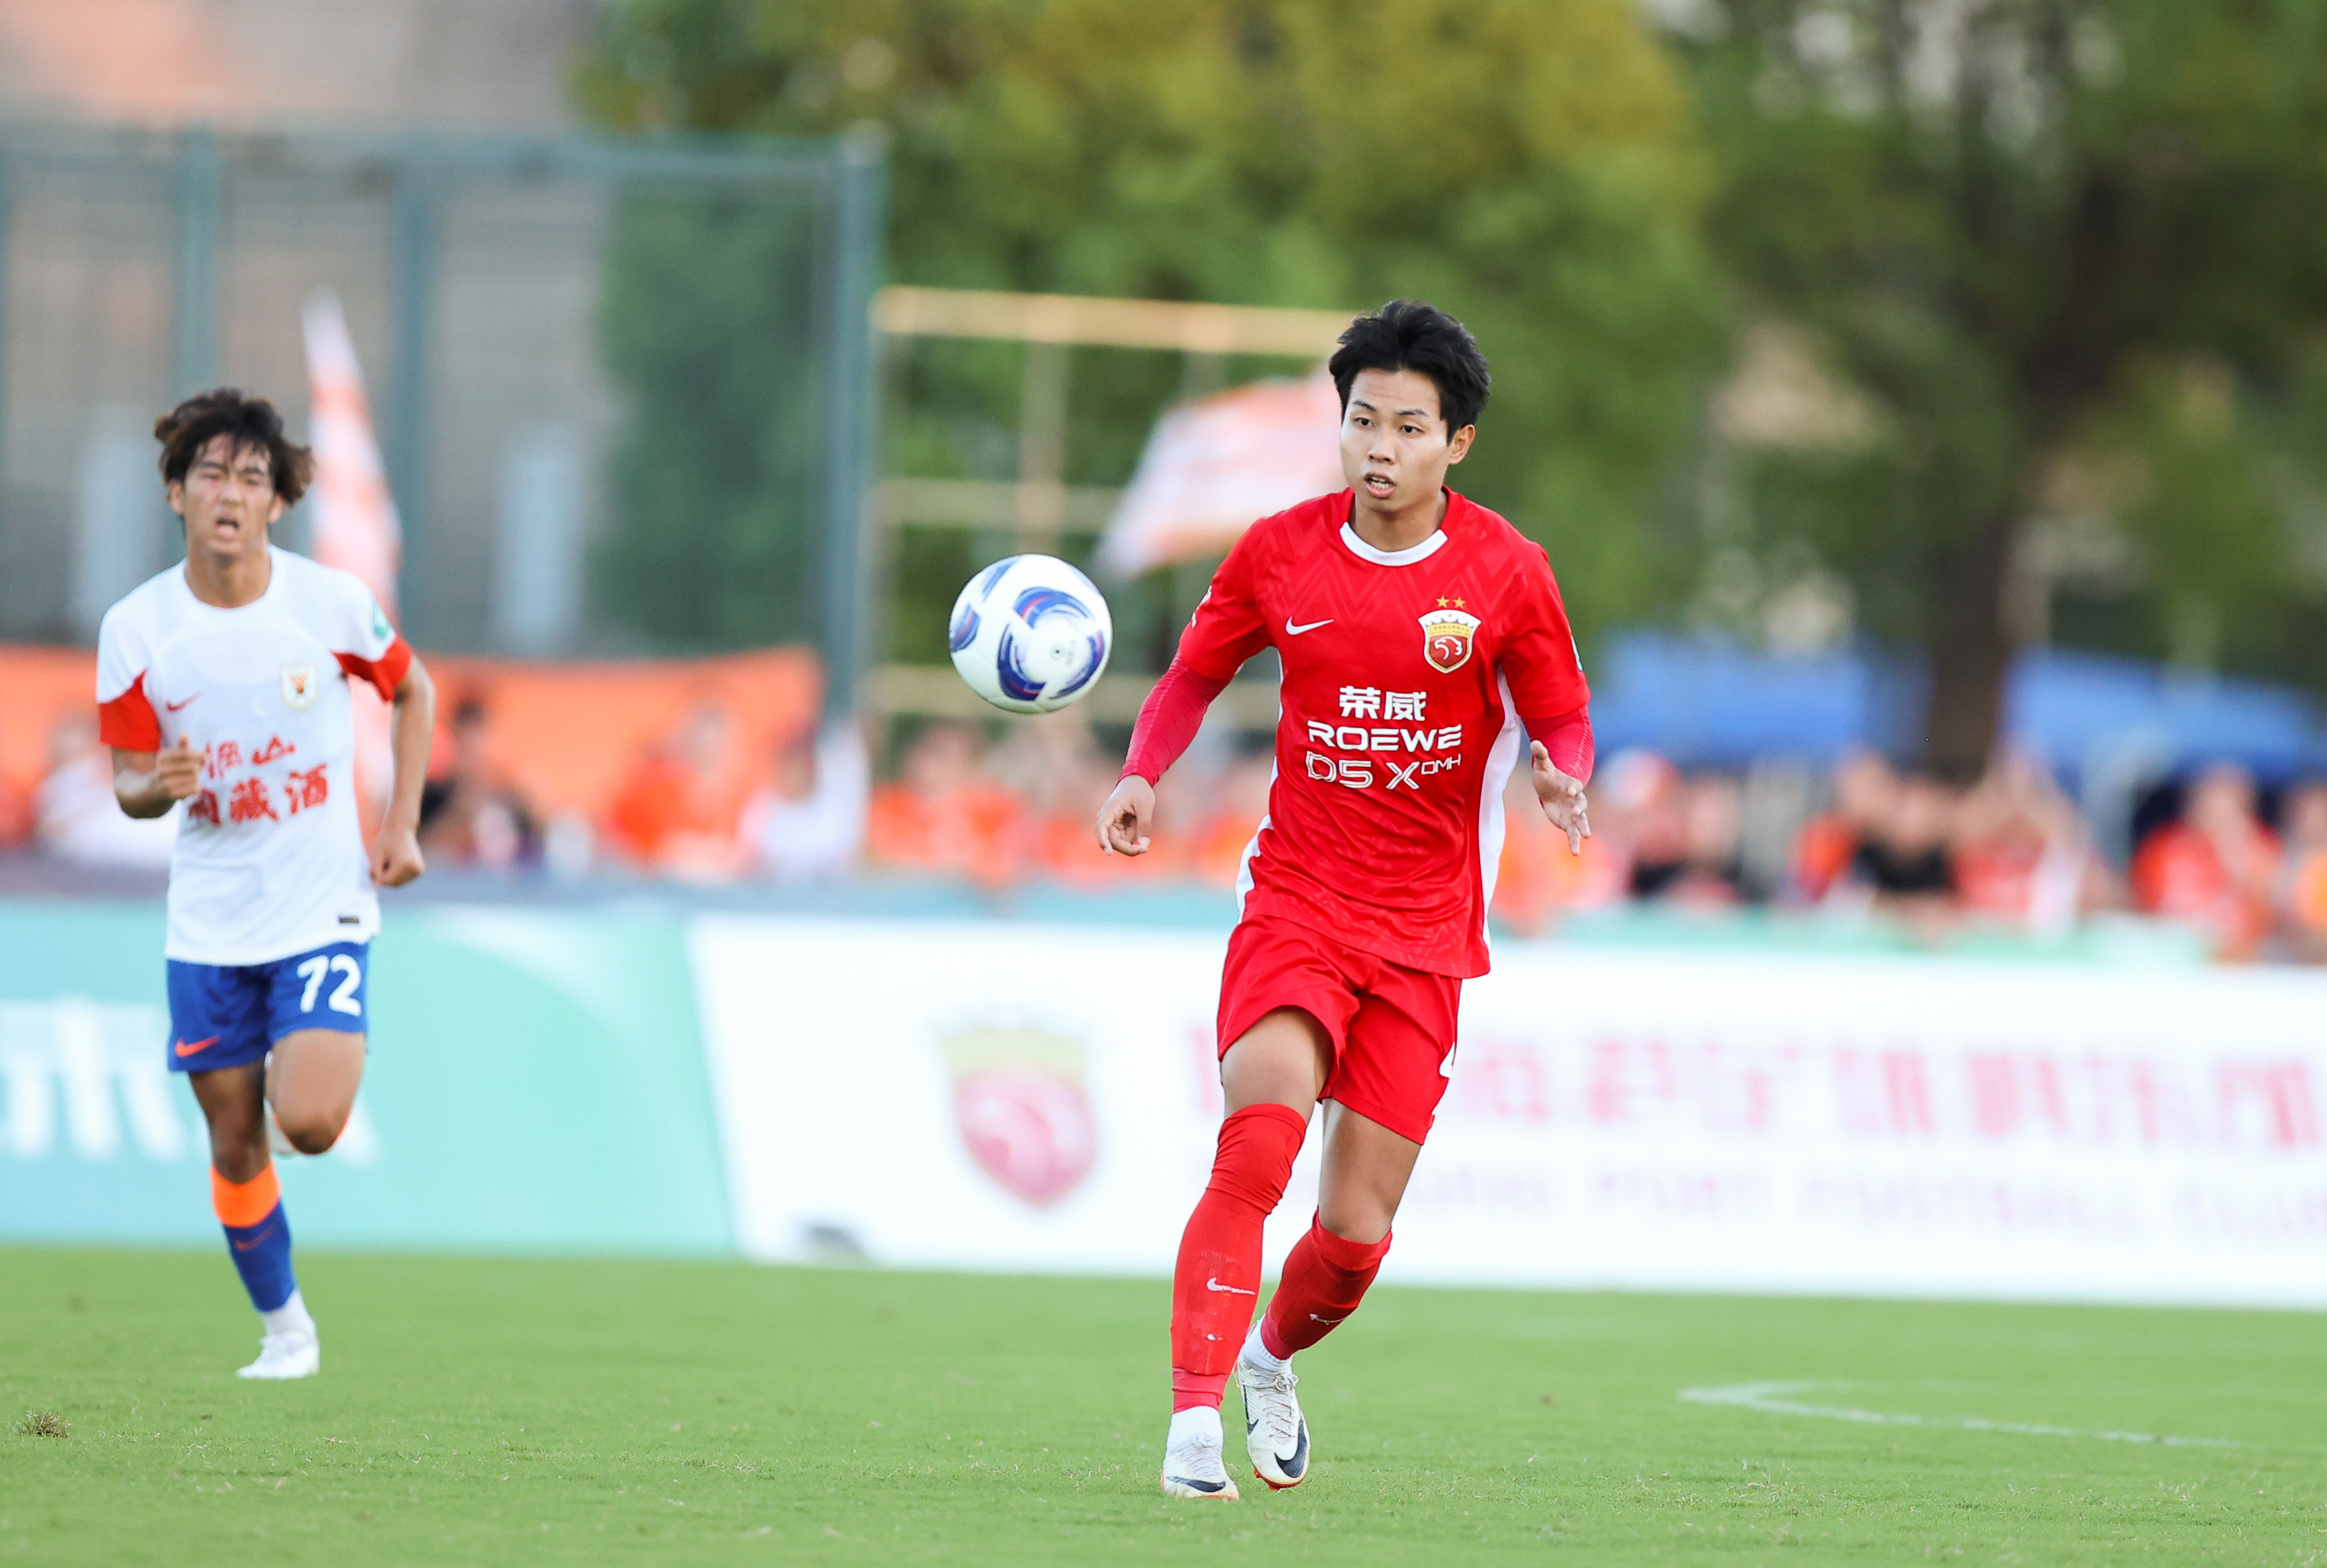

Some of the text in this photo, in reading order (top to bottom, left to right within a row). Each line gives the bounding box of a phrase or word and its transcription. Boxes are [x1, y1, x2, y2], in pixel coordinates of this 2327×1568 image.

[1339, 685, 1427, 722] 荣威
[1307, 720, 1462, 753] ROEWE
[1305, 750, 1373, 789] D5
[296, 953, 363, 1018] 72
